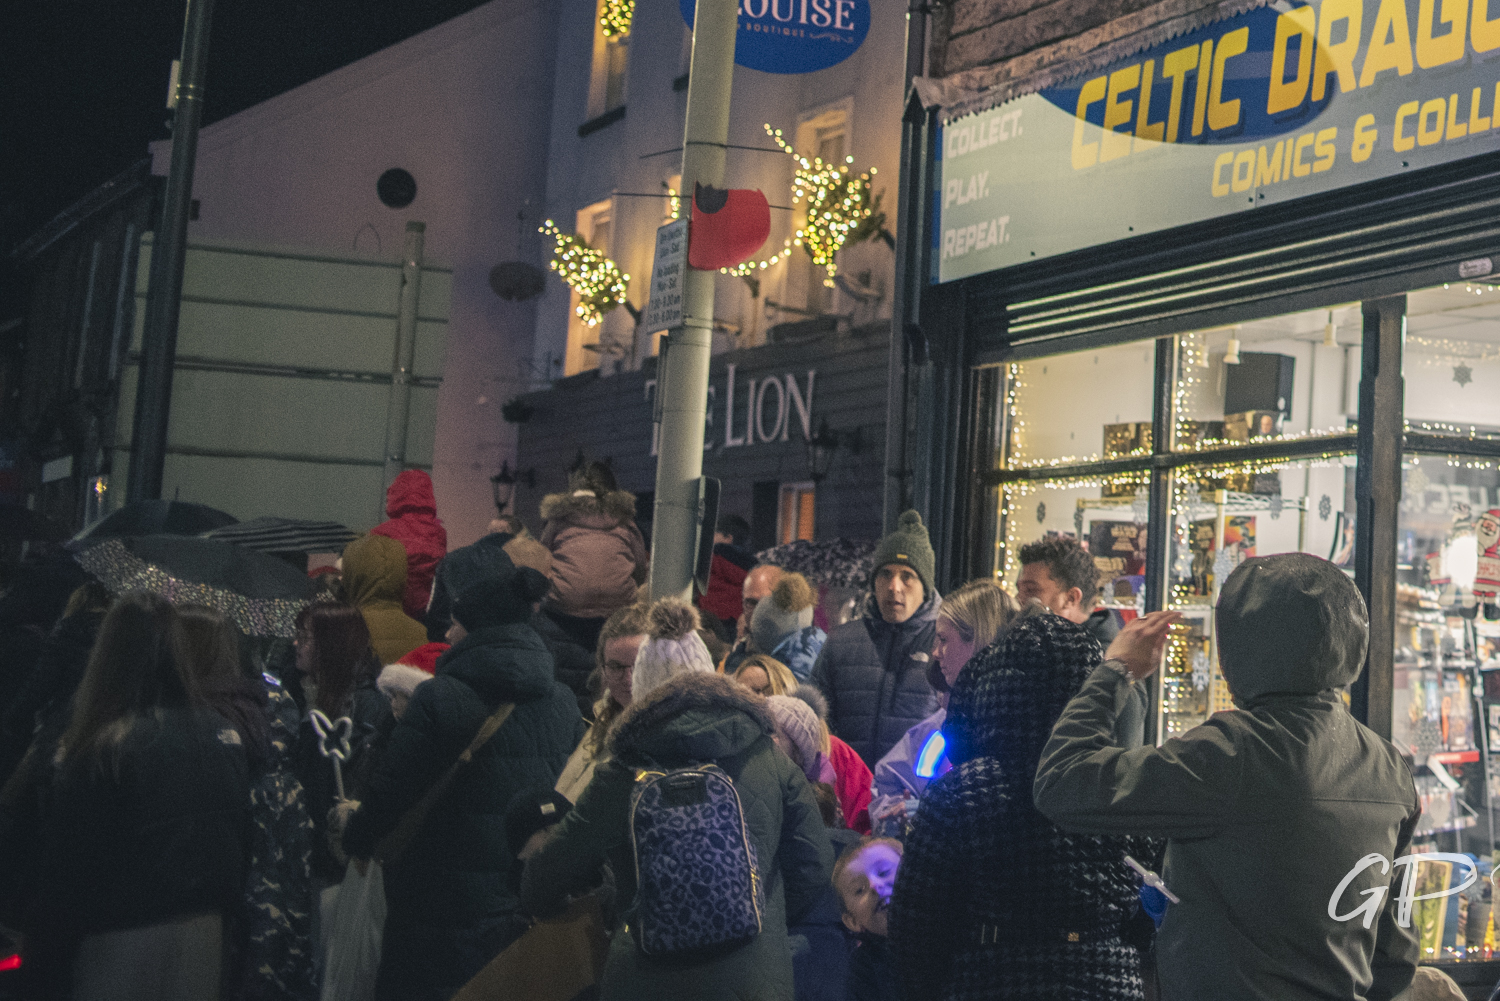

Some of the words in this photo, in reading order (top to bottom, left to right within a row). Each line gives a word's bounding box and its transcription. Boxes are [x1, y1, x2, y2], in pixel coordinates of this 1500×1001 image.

[1071, 25, 1249, 170] CELTIC
[948, 109, 1023, 158] COLLECT.
[1211, 125, 1337, 198] COMICS
[1350, 114, 1378, 163] &
[945, 171, 989, 209] PLAY.
[944, 215, 1010, 259] REPEAT.
